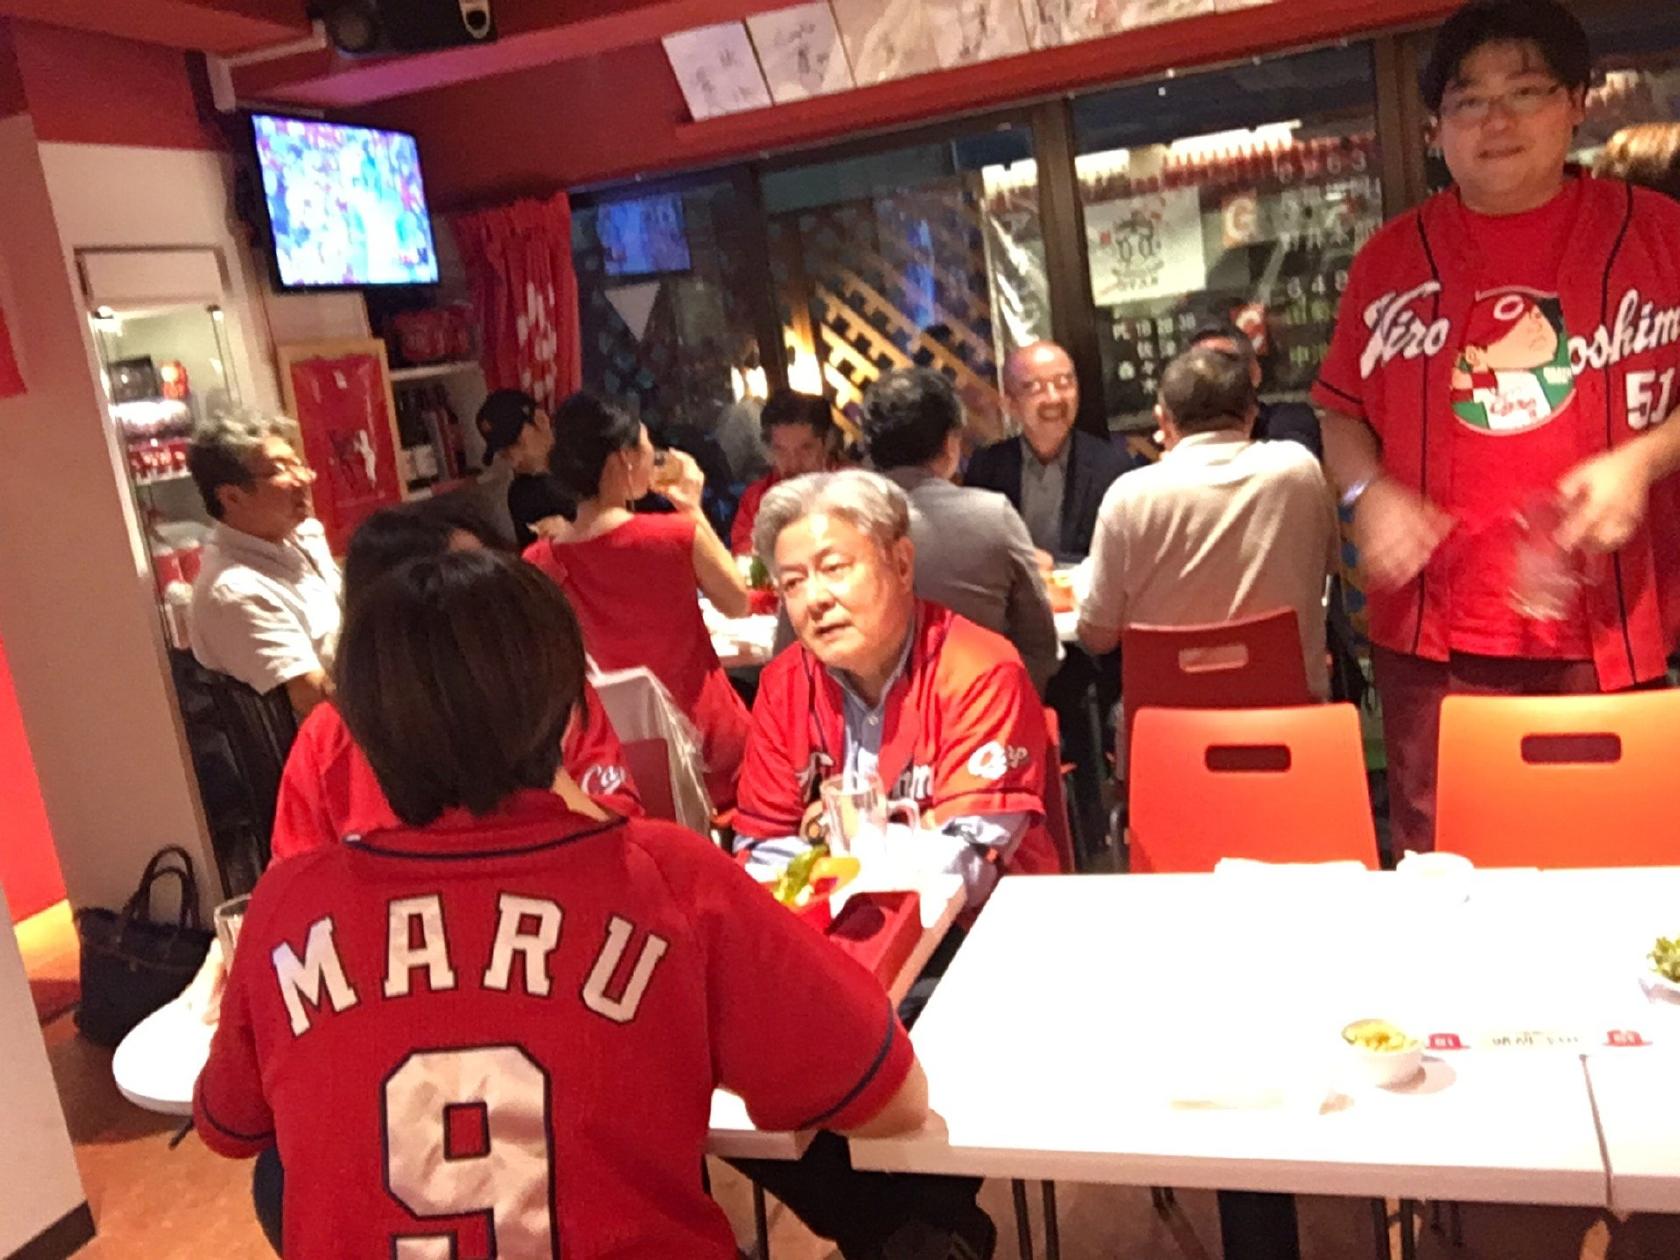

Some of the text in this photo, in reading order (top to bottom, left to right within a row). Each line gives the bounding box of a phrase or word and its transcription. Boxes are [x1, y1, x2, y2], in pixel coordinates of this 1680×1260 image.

[1625, 367, 1676, 430] 51
[270, 890, 668, 1037] MARU
[380, 1042, 557, 1260] 9
